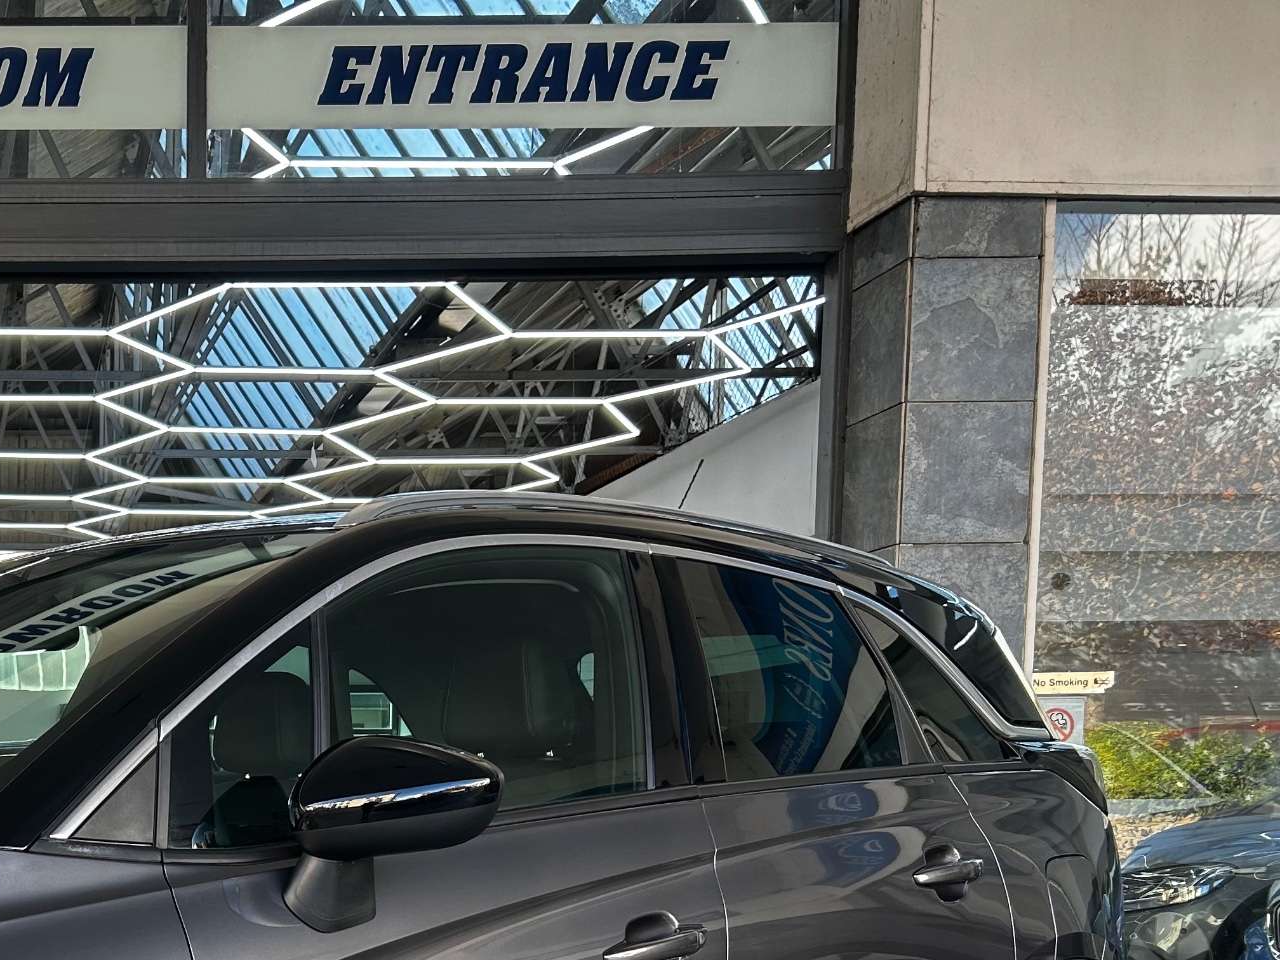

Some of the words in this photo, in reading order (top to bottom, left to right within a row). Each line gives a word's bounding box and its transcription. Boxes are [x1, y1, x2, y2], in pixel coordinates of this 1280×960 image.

[316, 39, 731, 106] ENTRANCE
[1033, 679, 1046, 687] No
[1049, 678, 1089, 688] Smoking
